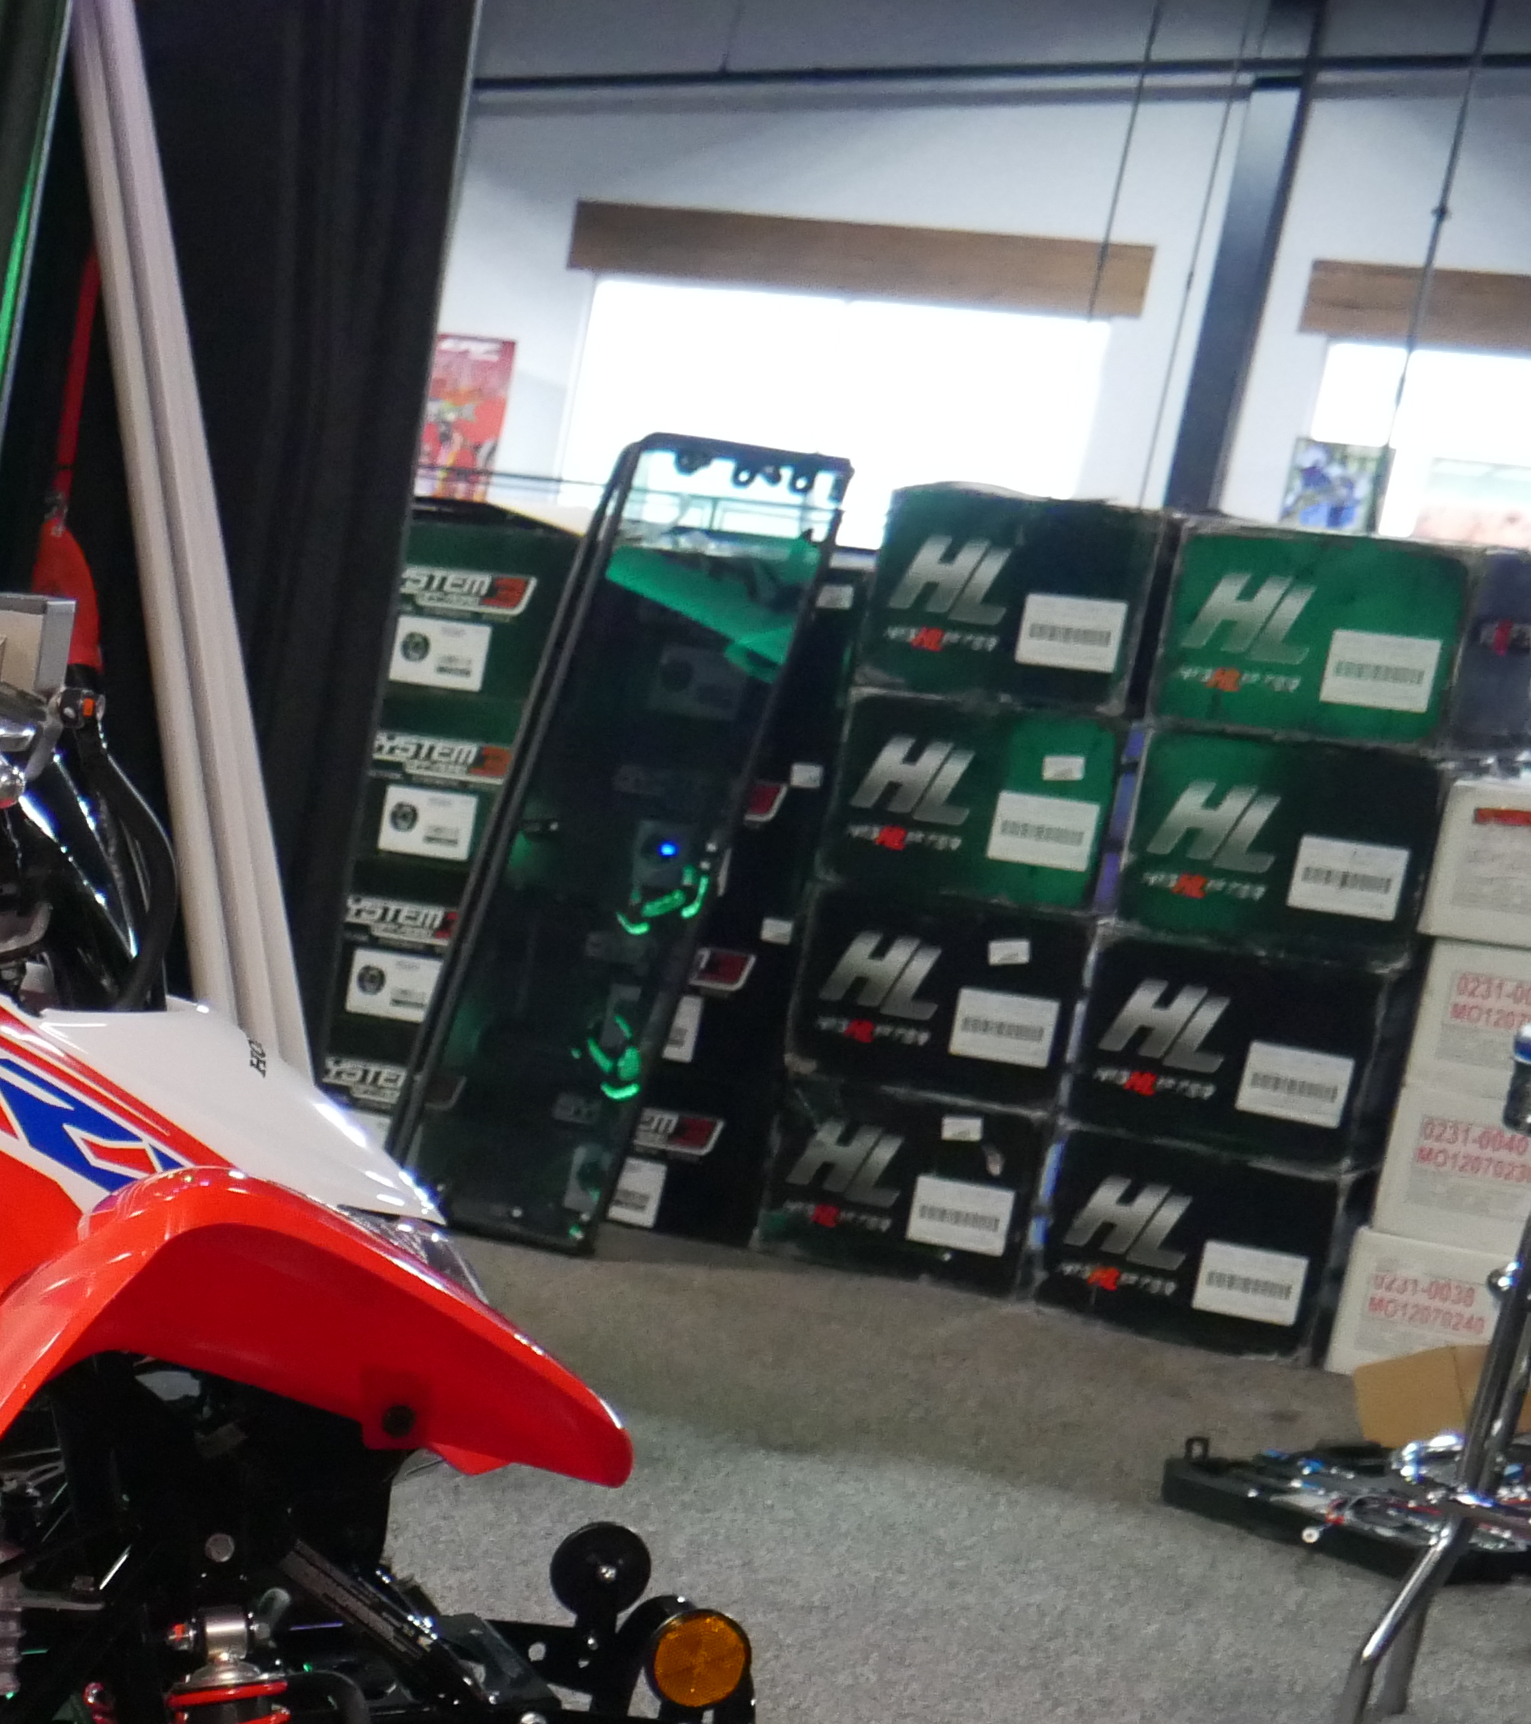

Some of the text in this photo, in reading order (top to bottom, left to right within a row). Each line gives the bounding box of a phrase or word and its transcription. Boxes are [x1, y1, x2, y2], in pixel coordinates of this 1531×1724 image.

[400, 566, 492, 597] STEM
[886, 535, 1012, 625] HL
[1180, 572, 1317, 665] HL
[372, 730, 479, 766] YSTEM
[850, 736, 976, 826] HL
[1147, 779, 1282, 873] HL
[345, 893, 445, 930] YSTEM
[818, 930, 941, 1020] HL
[1098, 977, 1231, 1073] HL
[786, 1117, 905, 1210] HL
[1064, 1175, 1193, 1270] HL
